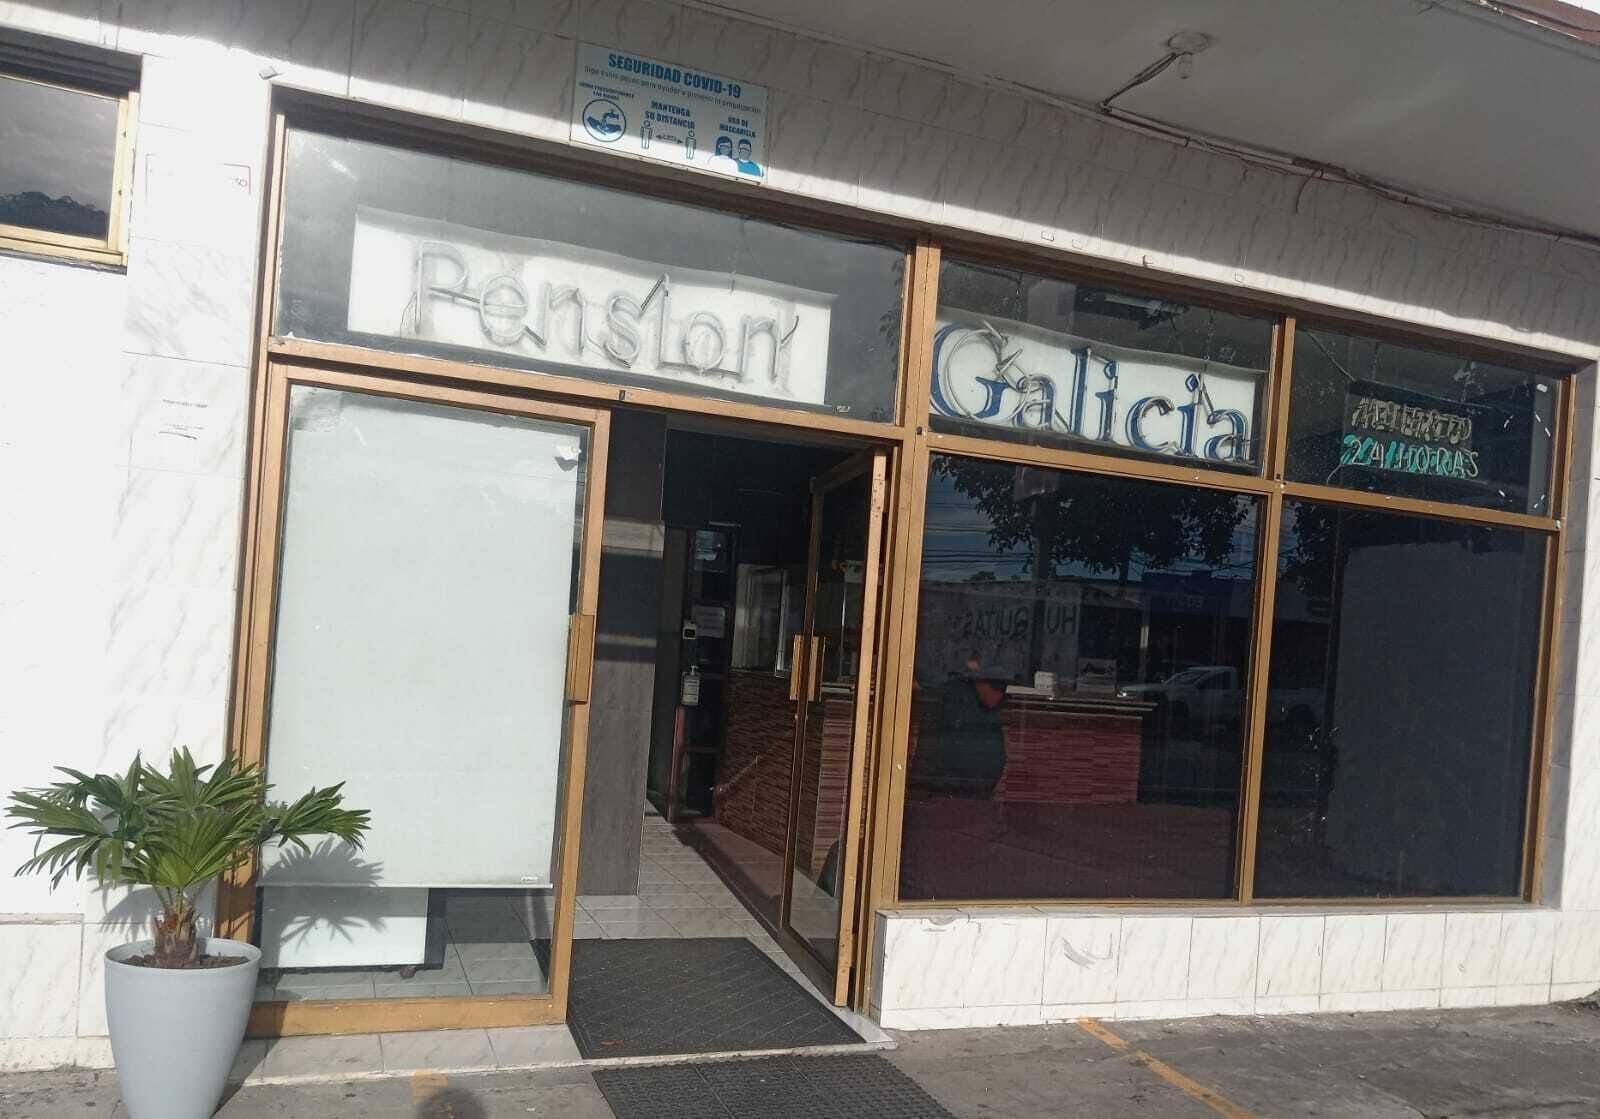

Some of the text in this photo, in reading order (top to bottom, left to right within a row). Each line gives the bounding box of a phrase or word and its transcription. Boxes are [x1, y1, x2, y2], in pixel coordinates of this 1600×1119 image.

[608, 53, 742, 98] SEGURIDAD COVID-19
[651, 101, 690, 117] MANTENGA
[656, 113, 695, 130] DISTANCIA
[930, 322, 1254, 465] Galicia
